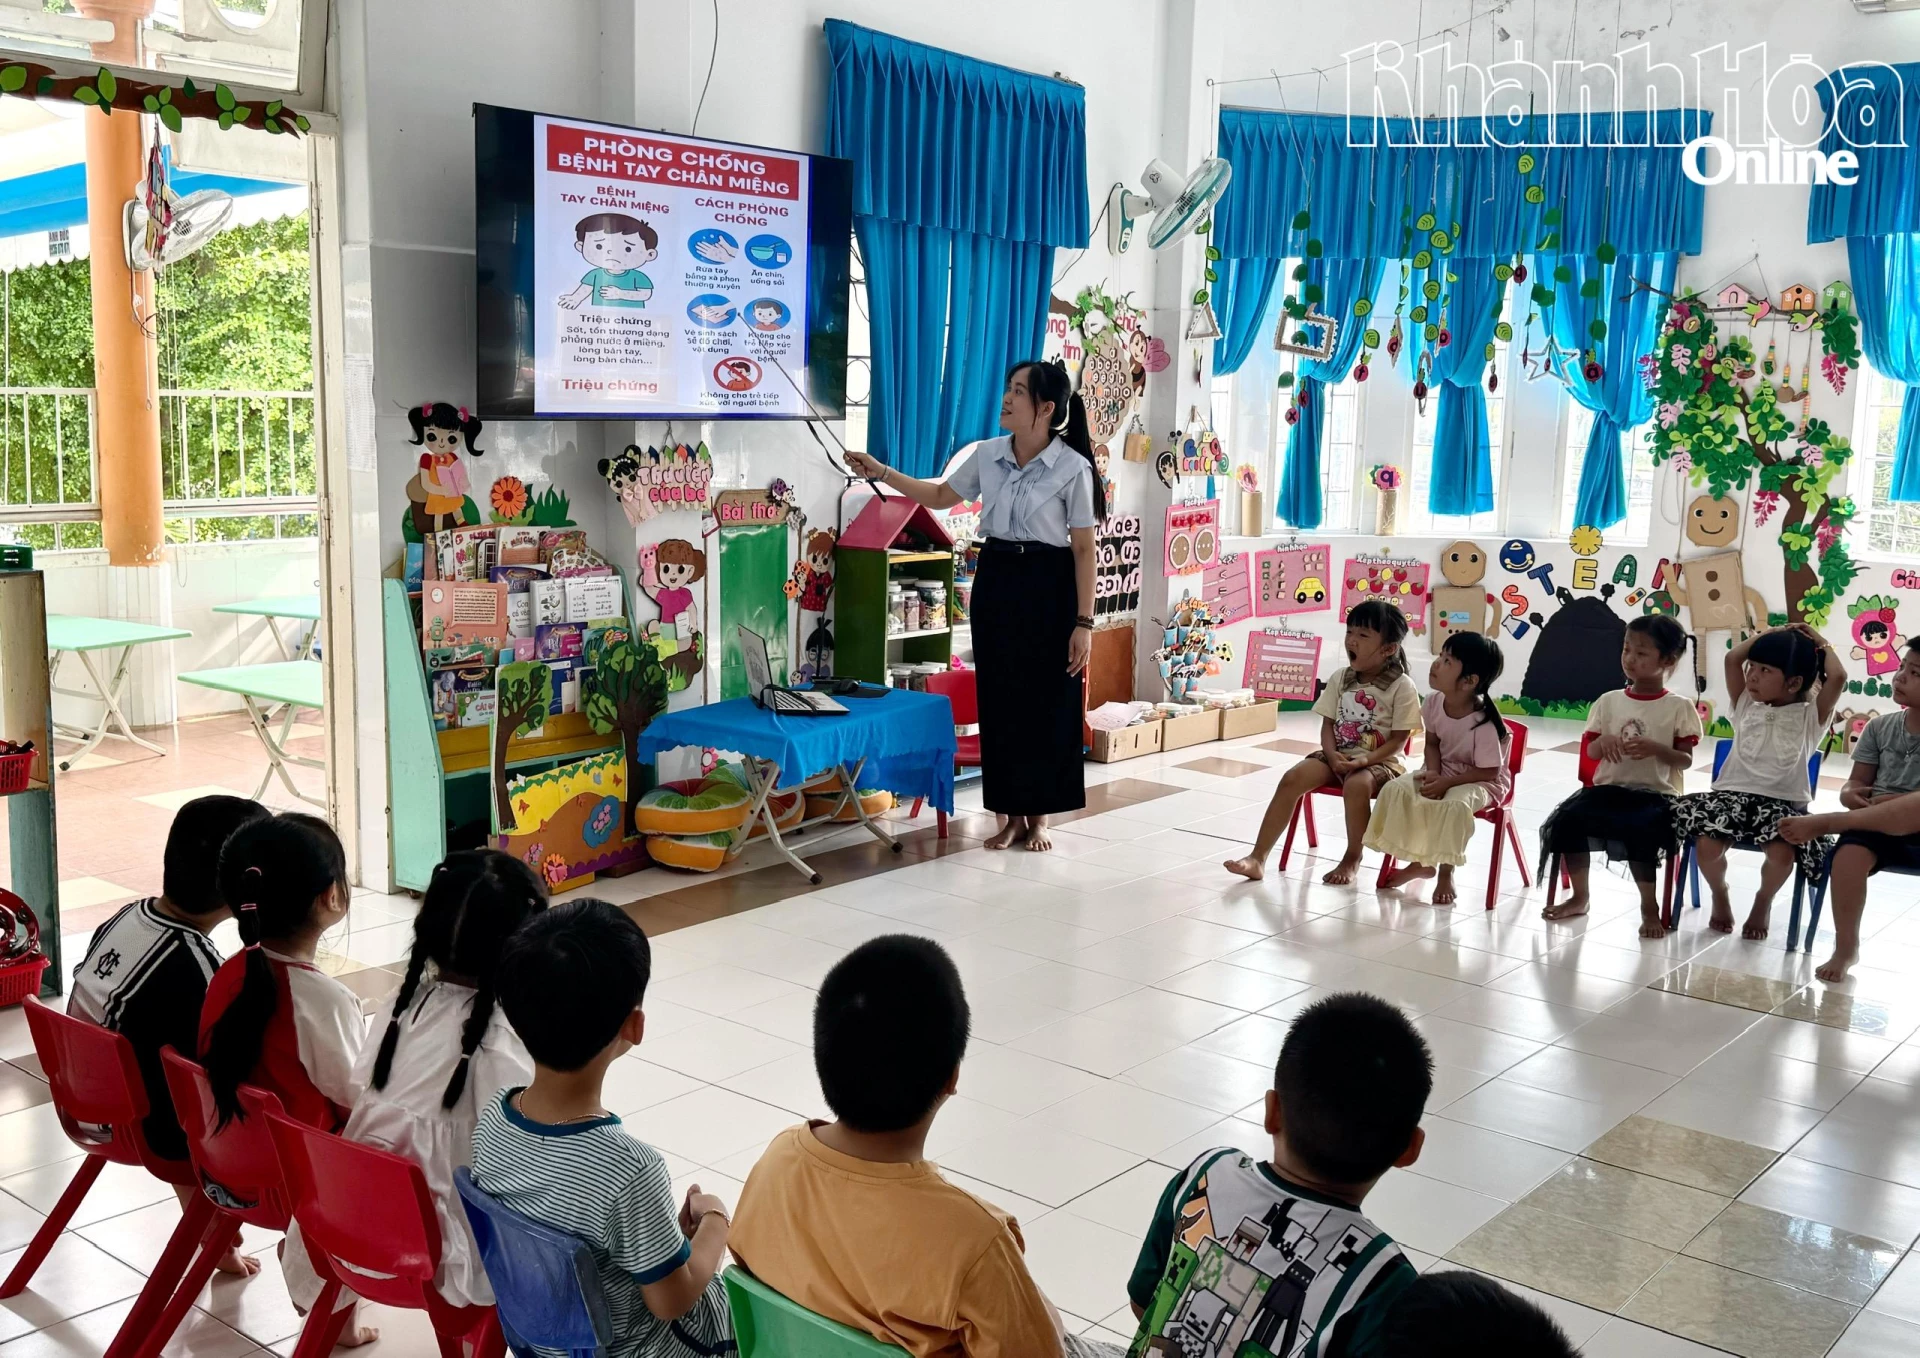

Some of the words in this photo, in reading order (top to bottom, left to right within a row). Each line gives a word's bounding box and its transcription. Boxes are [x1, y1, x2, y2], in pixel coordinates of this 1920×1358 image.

[584, 136, 673, 162] PHÒNG
[680, 151, 766, 175] CHỐNG
[558, 152, 617, 173] BỆNH
[624, 161, 662, 178] TAY
[666, 167, 723, 187] CHÂN
[728, 176, 790, 195] MIỆNG
[596, 185, 636, 198] BỆNH
[560, 193, 586, 204] TAY
[630, 200, 670, 214] MIỆNG
[694, 196, 734, 211] CÁCH
[738, 201, 789, 217] PHÒNG
[714, 211, 768, 227] CHỐNG
[708, 273, 718, 281] xà
[715, 267, 729, 275] tay
[579, 314, 611, 324] Triệu
[613, 316, 652, 328] chứng
[697, 329, 716, 337] sinh
[1062, 339, 1082, 361] tìm
[1763, 361, 1774, 376] 5
[561, 379, 604, 393] Triệu
[607, 380, 658, 394] chứng
[1380, 470, 1394, 488] q
[649, 481, 683, 502] của
[684, 481, 707, 502] bé
[721, 499, 746, 521] Bài
